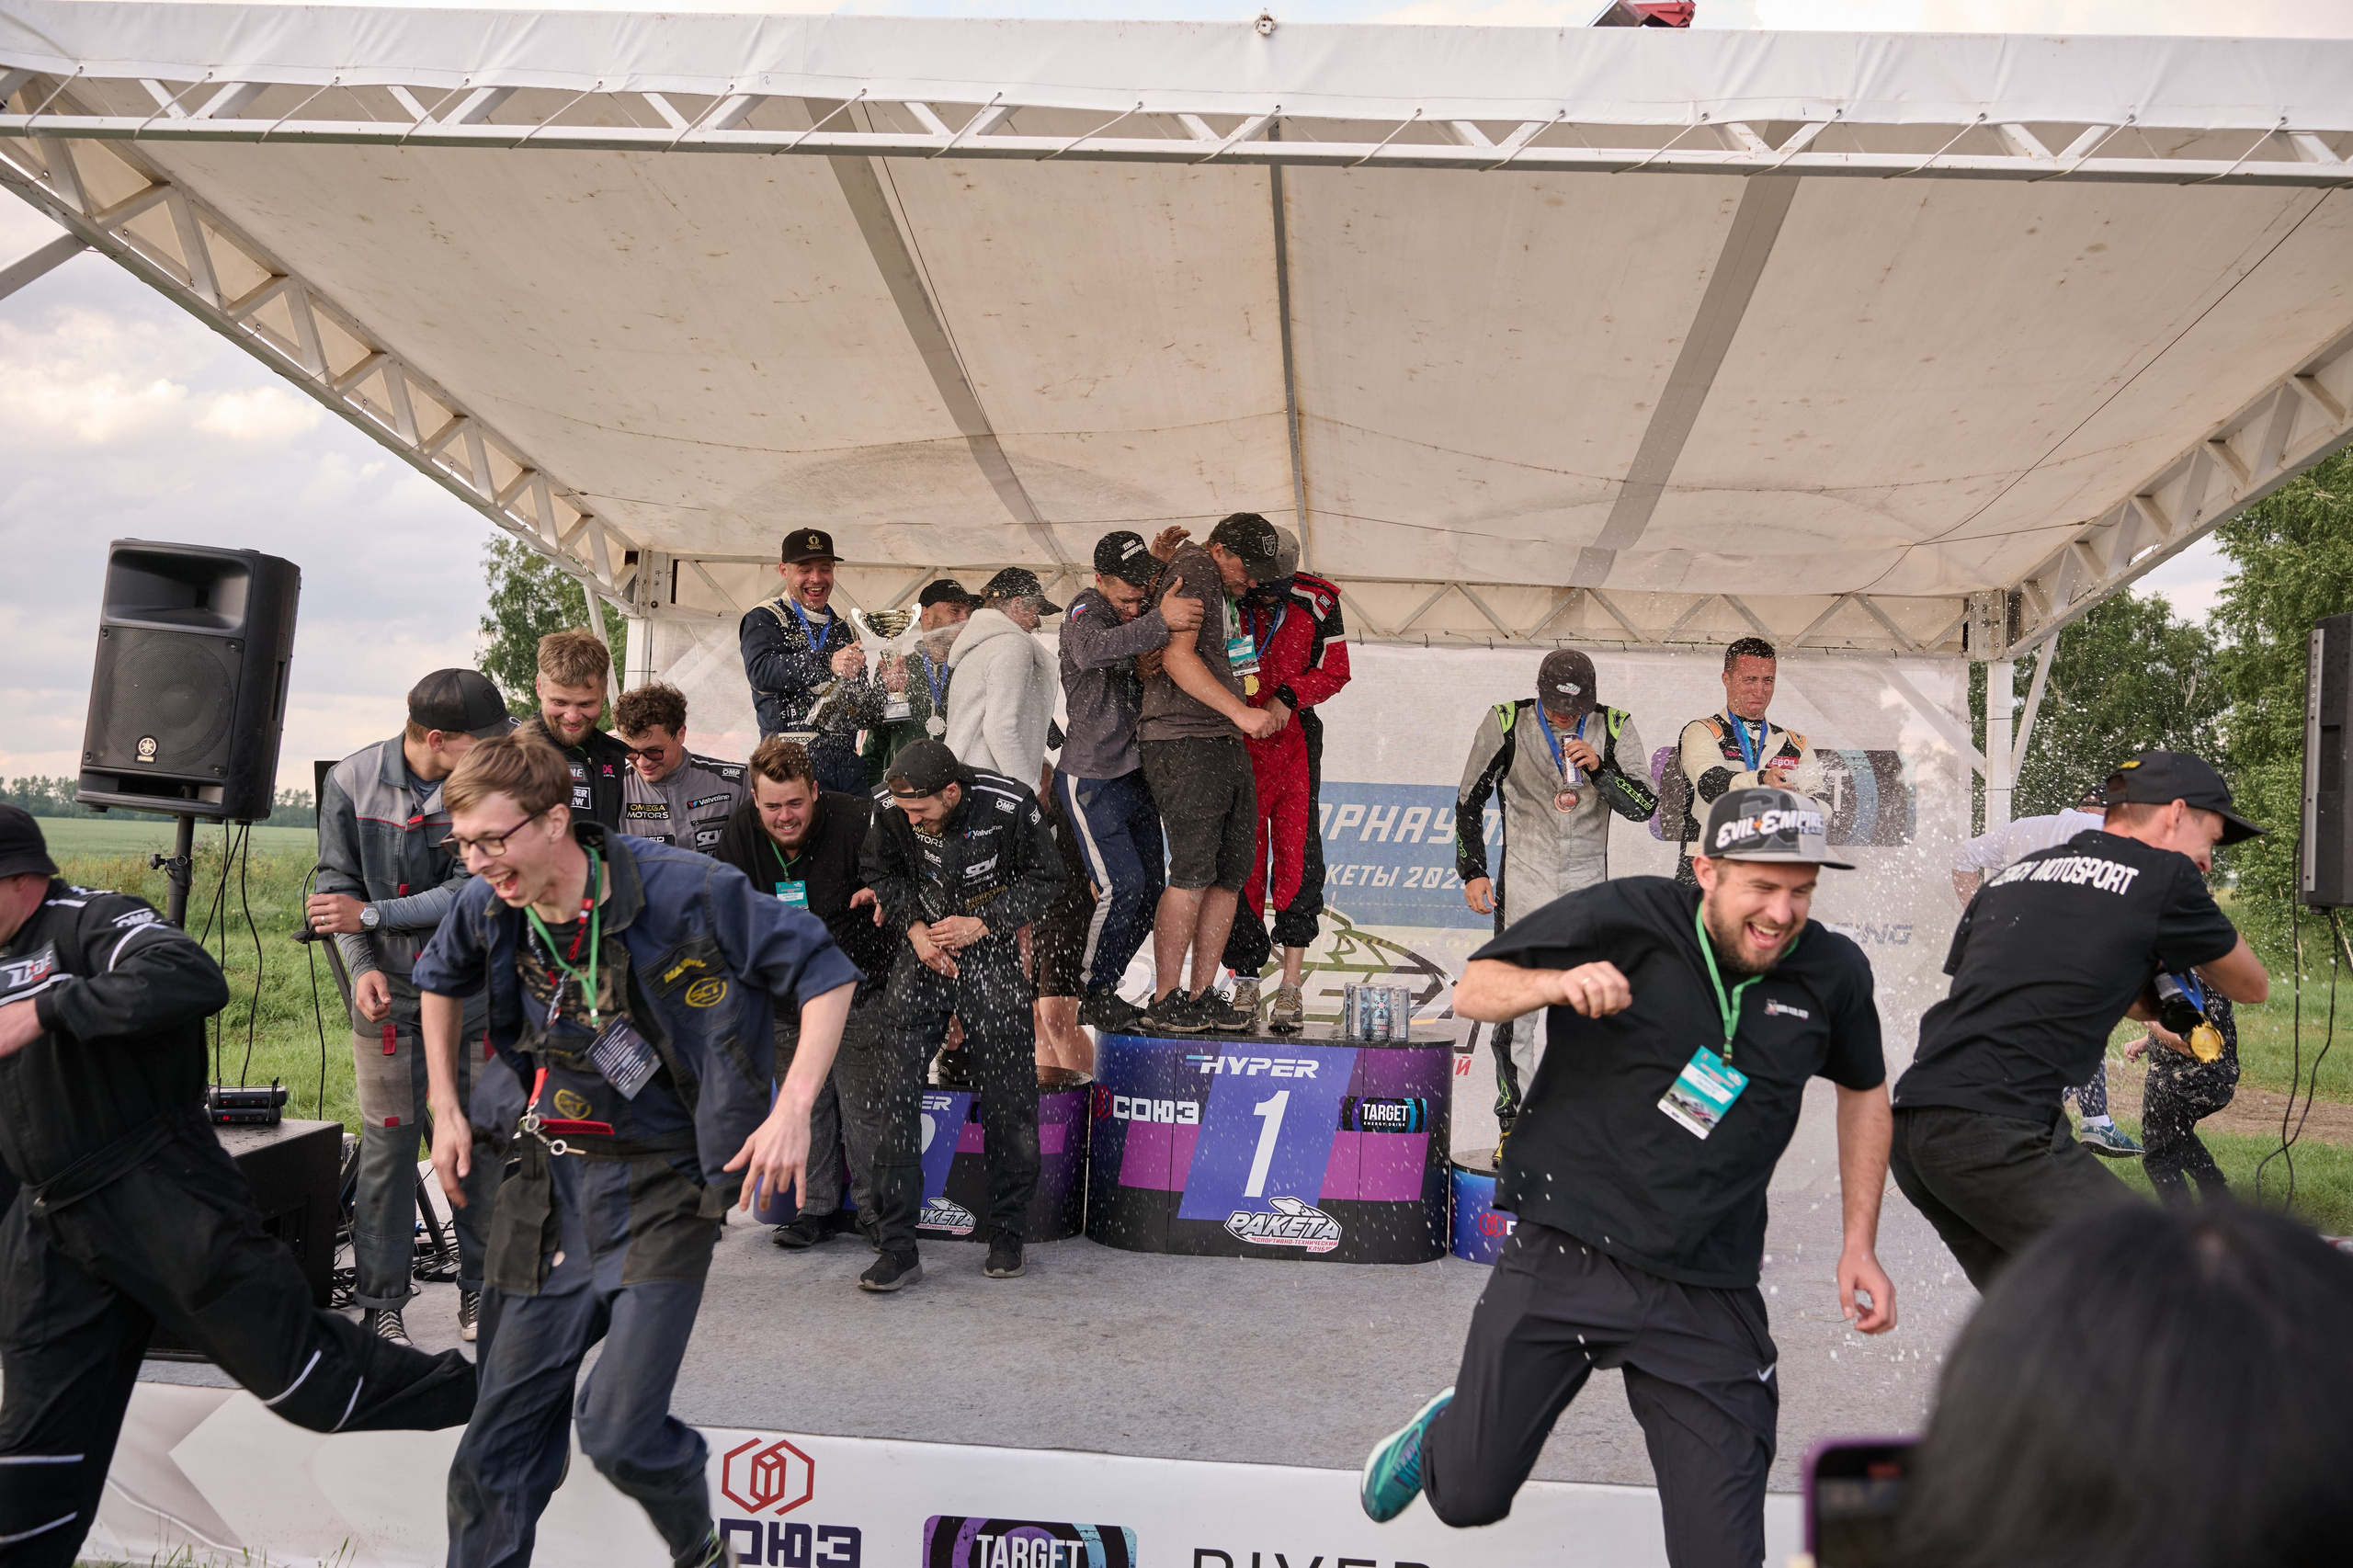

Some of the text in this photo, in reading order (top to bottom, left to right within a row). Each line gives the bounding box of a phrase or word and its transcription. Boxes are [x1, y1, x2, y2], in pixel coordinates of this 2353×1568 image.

[722, 768, 741, 777] OMP
[630, 803, 666, 812] OMEGA
[699, 793, 730, 805] Valvoline
[882, 799, 896, 809] OM
[996, 800, 1016, 812] OMP
[627, 811, 669, 819] MOTORS
[1715, 809, 1824, 848] EVIL EMPIRE
[1324, 864, 1466, 890] КЕТЫ 202
[2029, 856, 2140, 896] MOTOSPORT
[1199, 1055, 1320, 1079] HYPER
[1112, 1095, 1199, 1125] СОЮЗ
[1362, 1103, 1409, 1121] TARGET
[1244, 1090, 1290, 1198] 1
[1226, 1212, 1339, 1239] РАКЕТА
[1256, 1237, 1338, 1246] СПОРТИВНО-ТЕХНИЧЕСКИЙ
[713, 1517, 862, 1568] ОЮЗ
[975, 1534, 1084, 1568] TARGET
